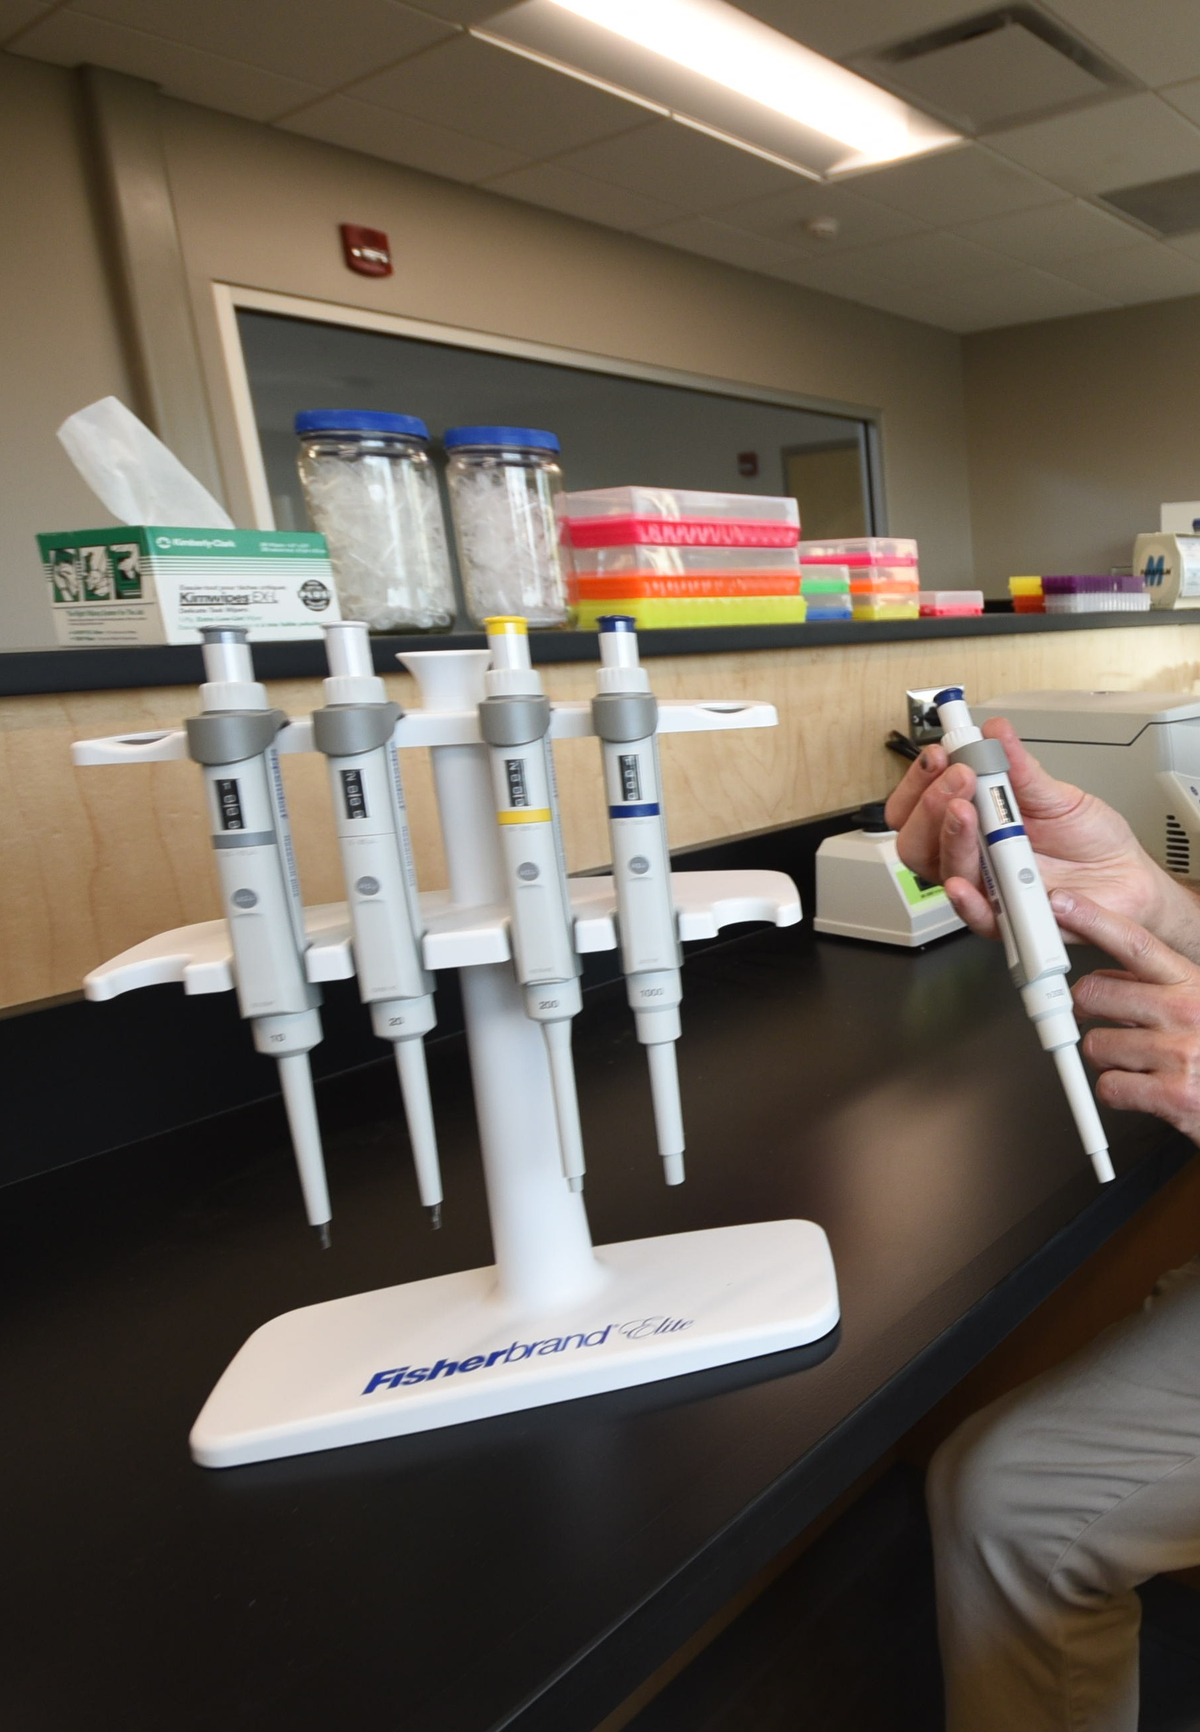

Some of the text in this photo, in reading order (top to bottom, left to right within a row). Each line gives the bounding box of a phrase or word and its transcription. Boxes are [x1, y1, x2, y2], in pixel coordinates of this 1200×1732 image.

[538, 999, 560, 1010] 200
[360, 1315, 696, 1396] Fisherbrand Elite
